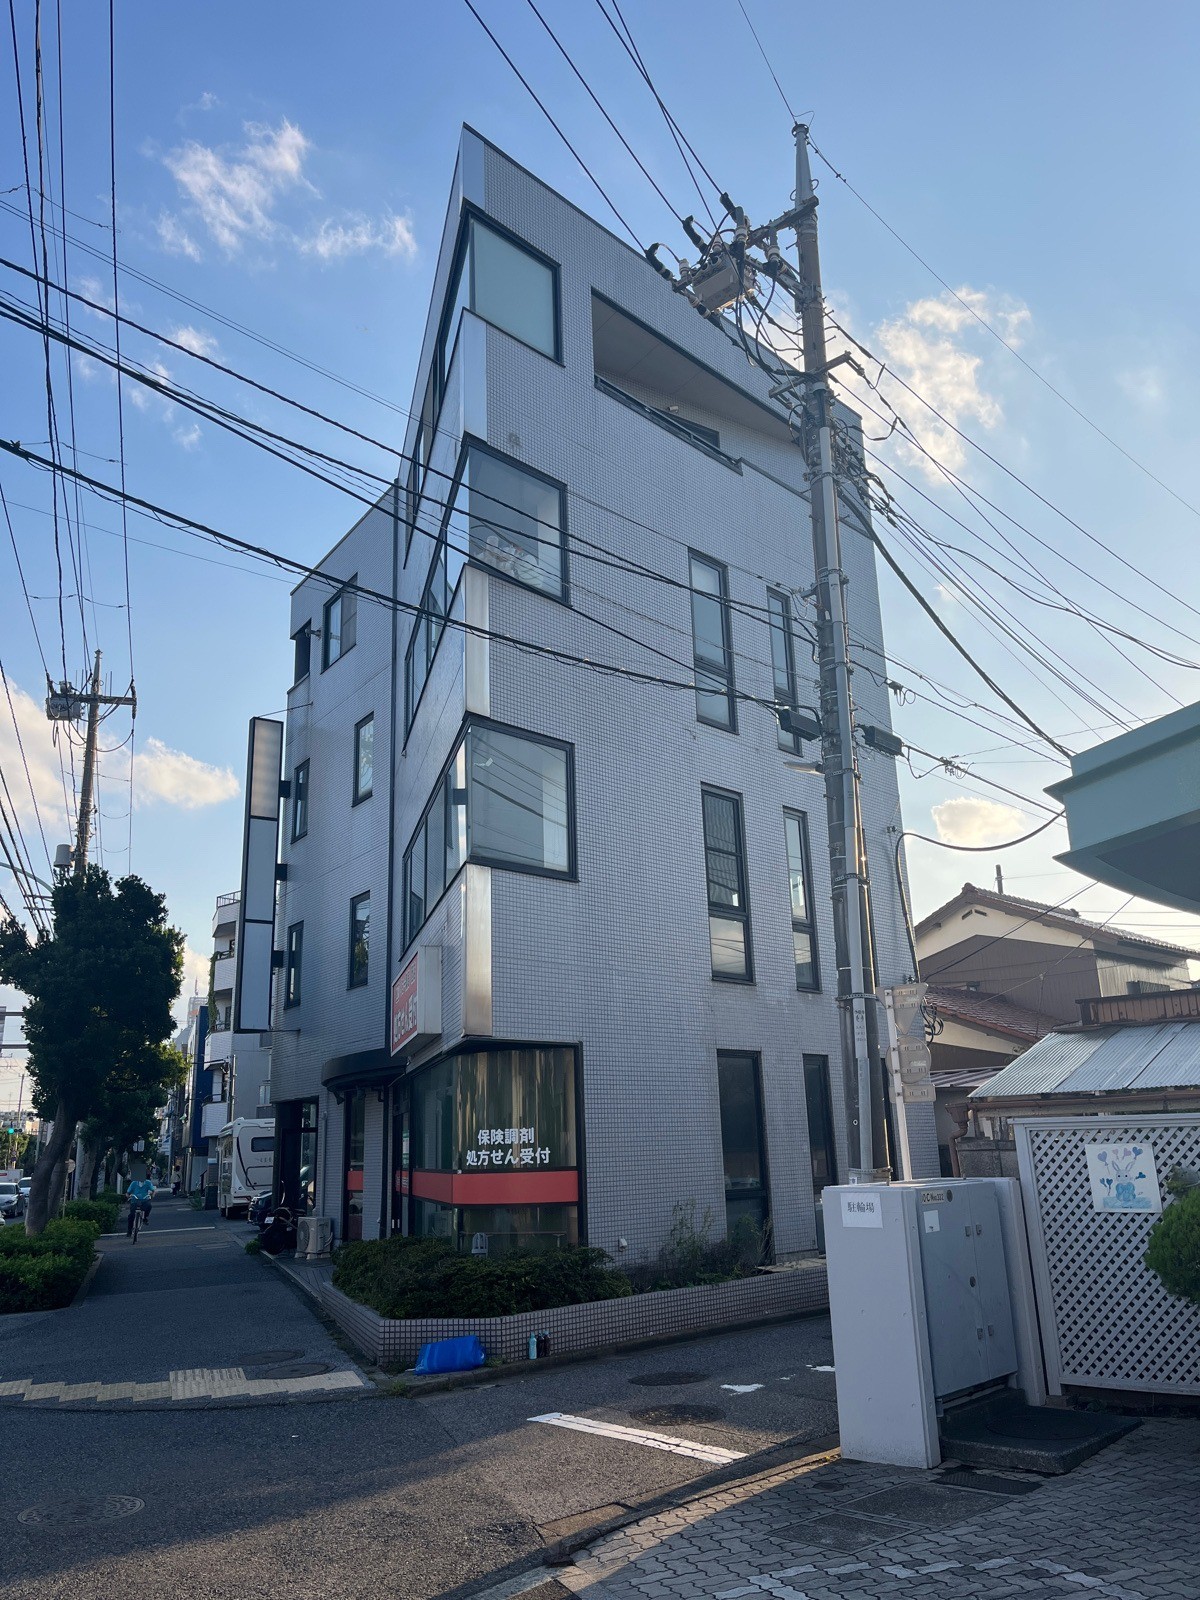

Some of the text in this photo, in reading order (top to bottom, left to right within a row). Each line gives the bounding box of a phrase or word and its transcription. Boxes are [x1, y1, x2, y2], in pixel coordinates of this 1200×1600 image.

[477, 1127, 535, 1145] 保険調剤
[466, 1147, 551, 1166] 処方せん受付
[847, 1201, 875, 1213] 駐輪場
